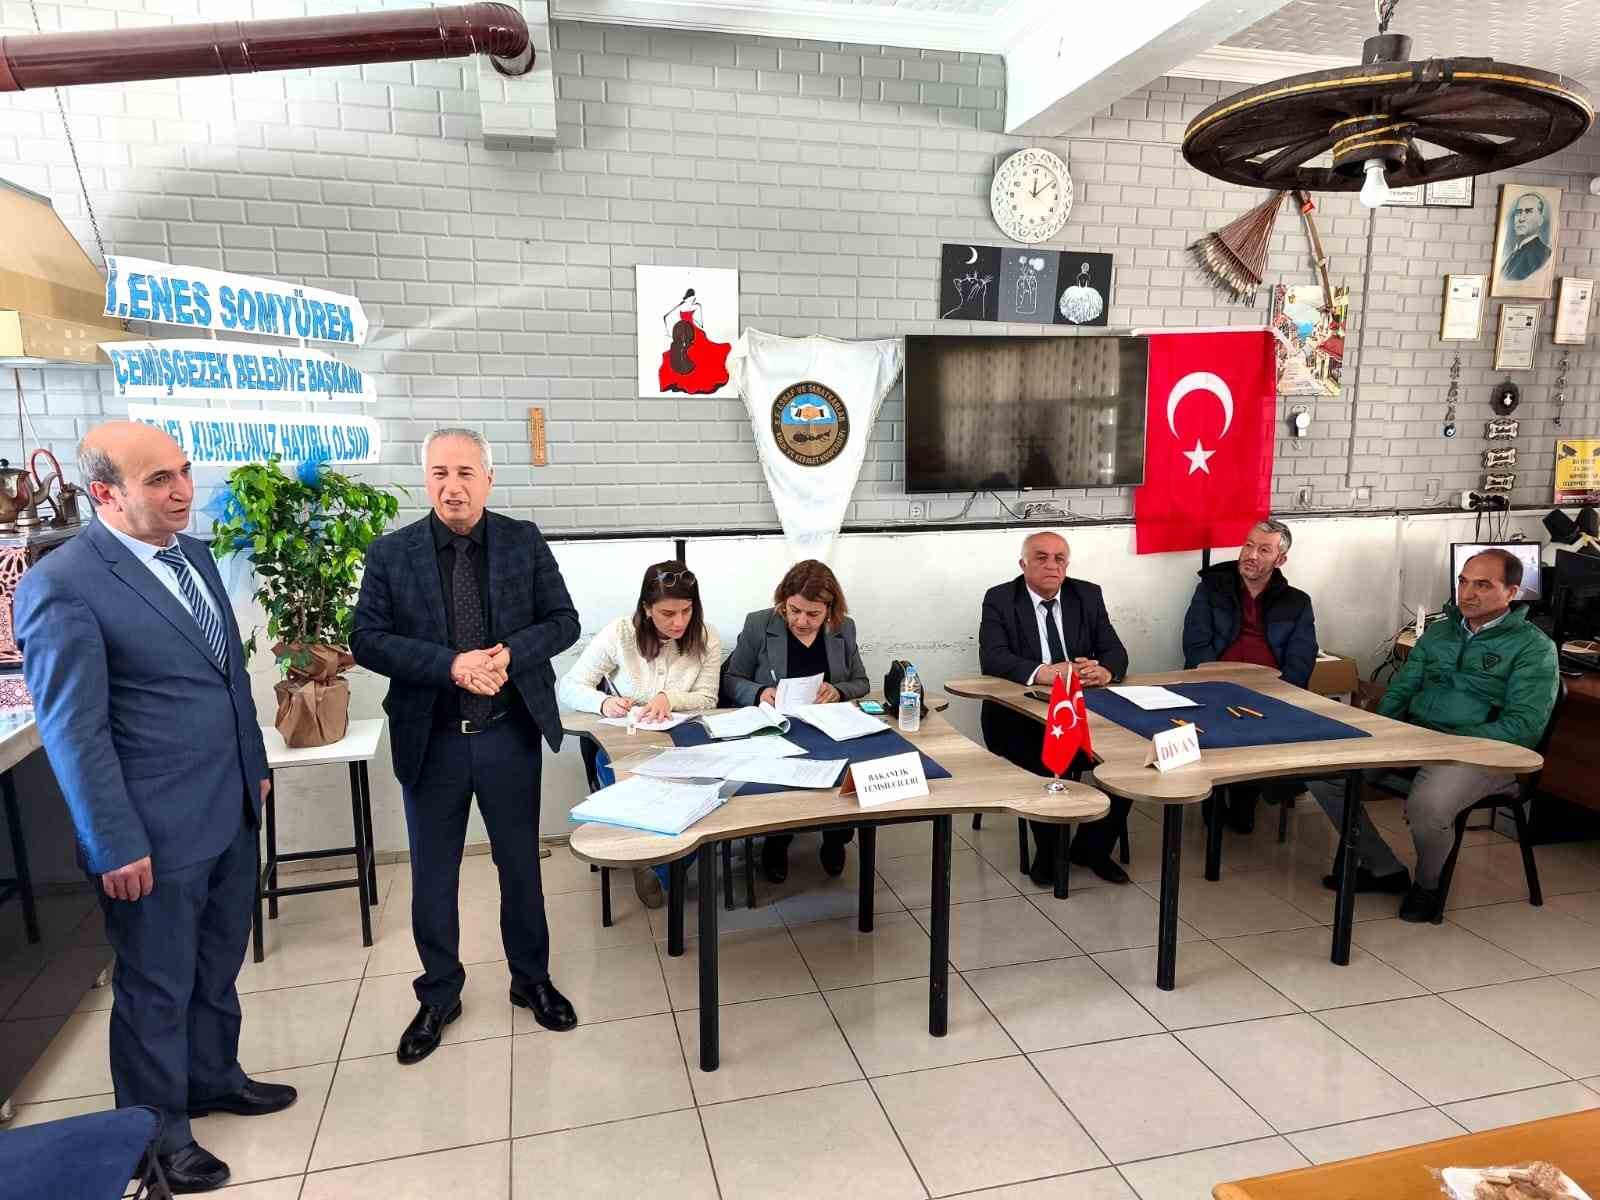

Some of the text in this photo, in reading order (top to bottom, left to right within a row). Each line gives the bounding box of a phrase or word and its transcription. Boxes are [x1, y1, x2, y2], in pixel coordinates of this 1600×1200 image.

[219, 284, 355, 342] SOMYÜREK
[110, 342, 364, 400] ÇEMİŞGEZEK BELEDİYE BAŞKANI
[188, 420, 276, 461] KURULUNUZ
[280, 423, 332, 461] HAYIRLI
[332, 425, 369, 460] OLSUN
